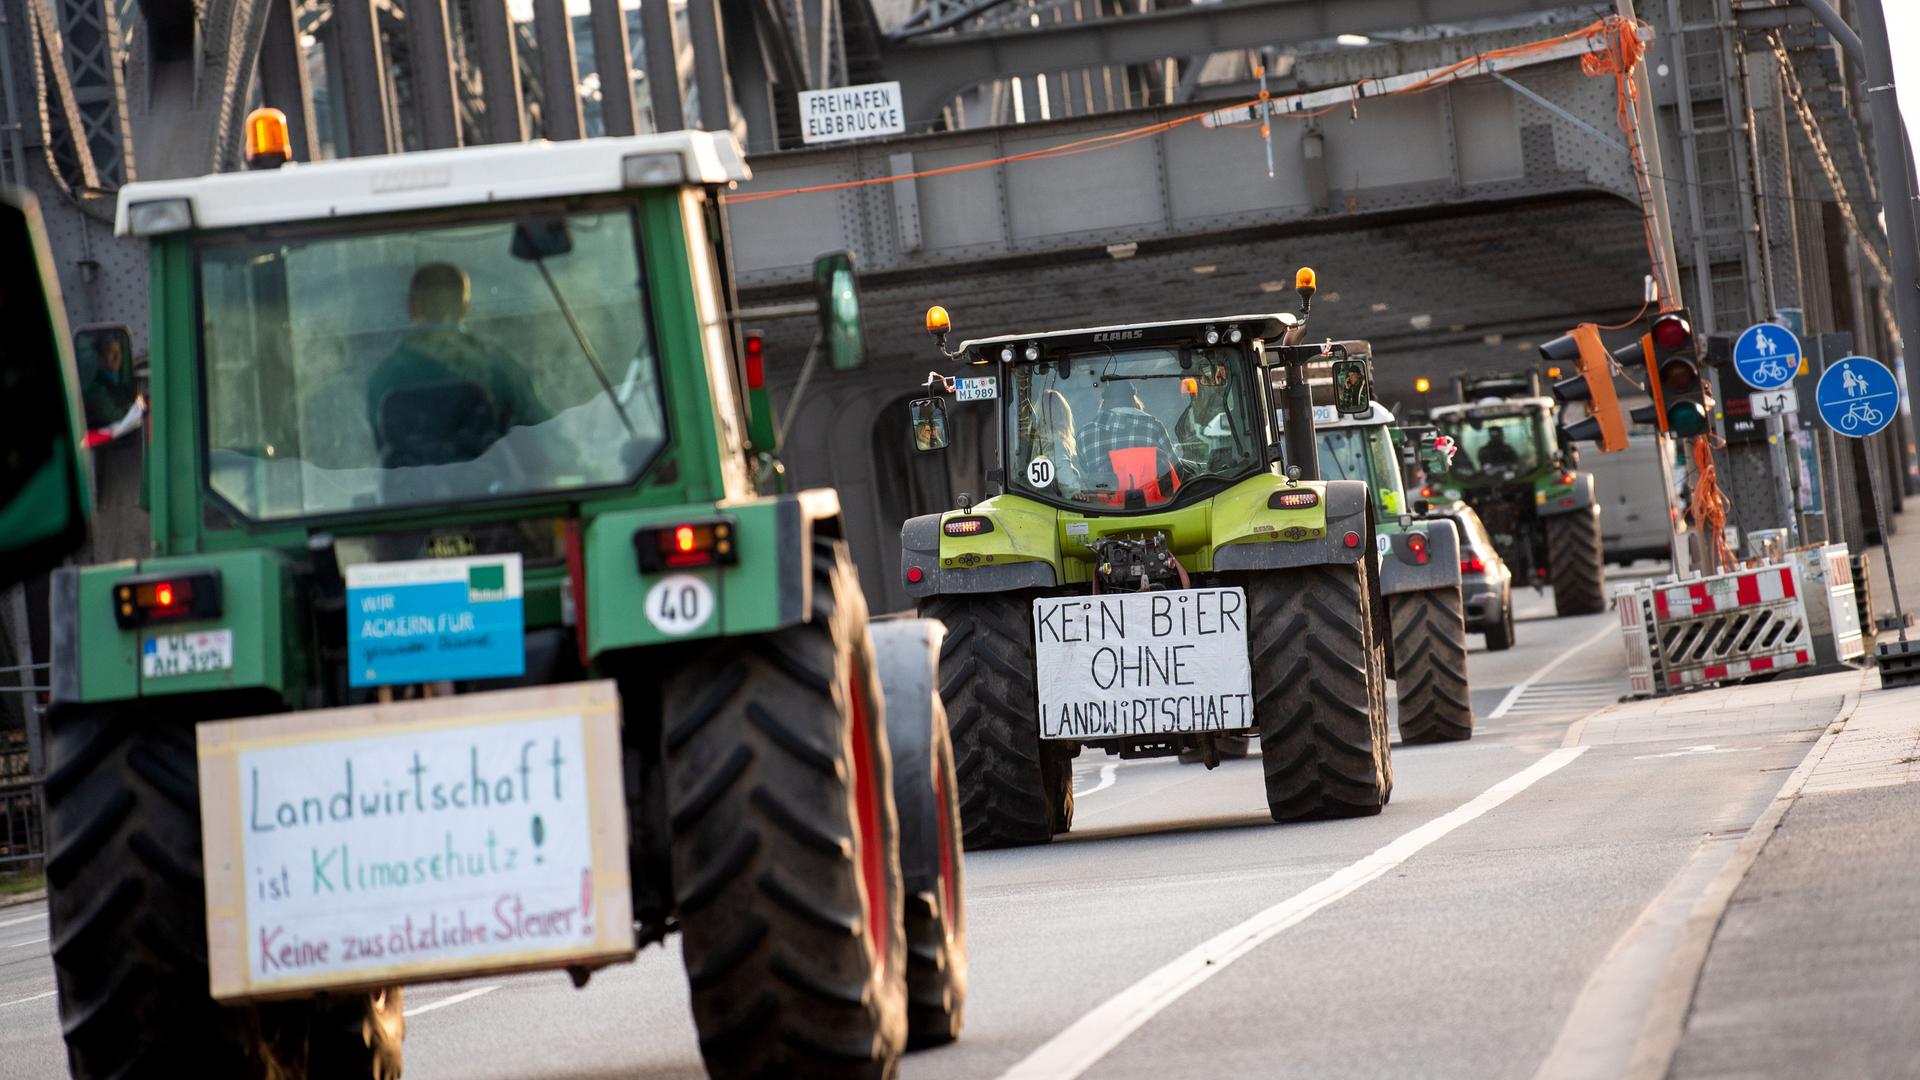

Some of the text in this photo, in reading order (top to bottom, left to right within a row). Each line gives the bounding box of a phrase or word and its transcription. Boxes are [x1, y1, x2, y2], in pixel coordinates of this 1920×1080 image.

[810, 88, 890, 115] FREIHAFEN
[809, 109, 898, 136] ELBBRÜCKE
[1094, 330, 1143, 342] CLAAS
[960, 388, 994, 399] MI 989
[964, 379, 978, 389] WL
[1313, 408, 1329, 419] 90
[1031, 461, 1050, 483] 50
[660, 586, 698, 621] 40
[361, 615, 435, 638] ACKERN
[1091, 644, 1195, 690] OHNE
[250, 736, 567, 833] Landwirtschaft
[256, 864, 291, 901] ist
[258, 925, 330, 974] Keine
[340, 909, 488, 963] zusätzliche
